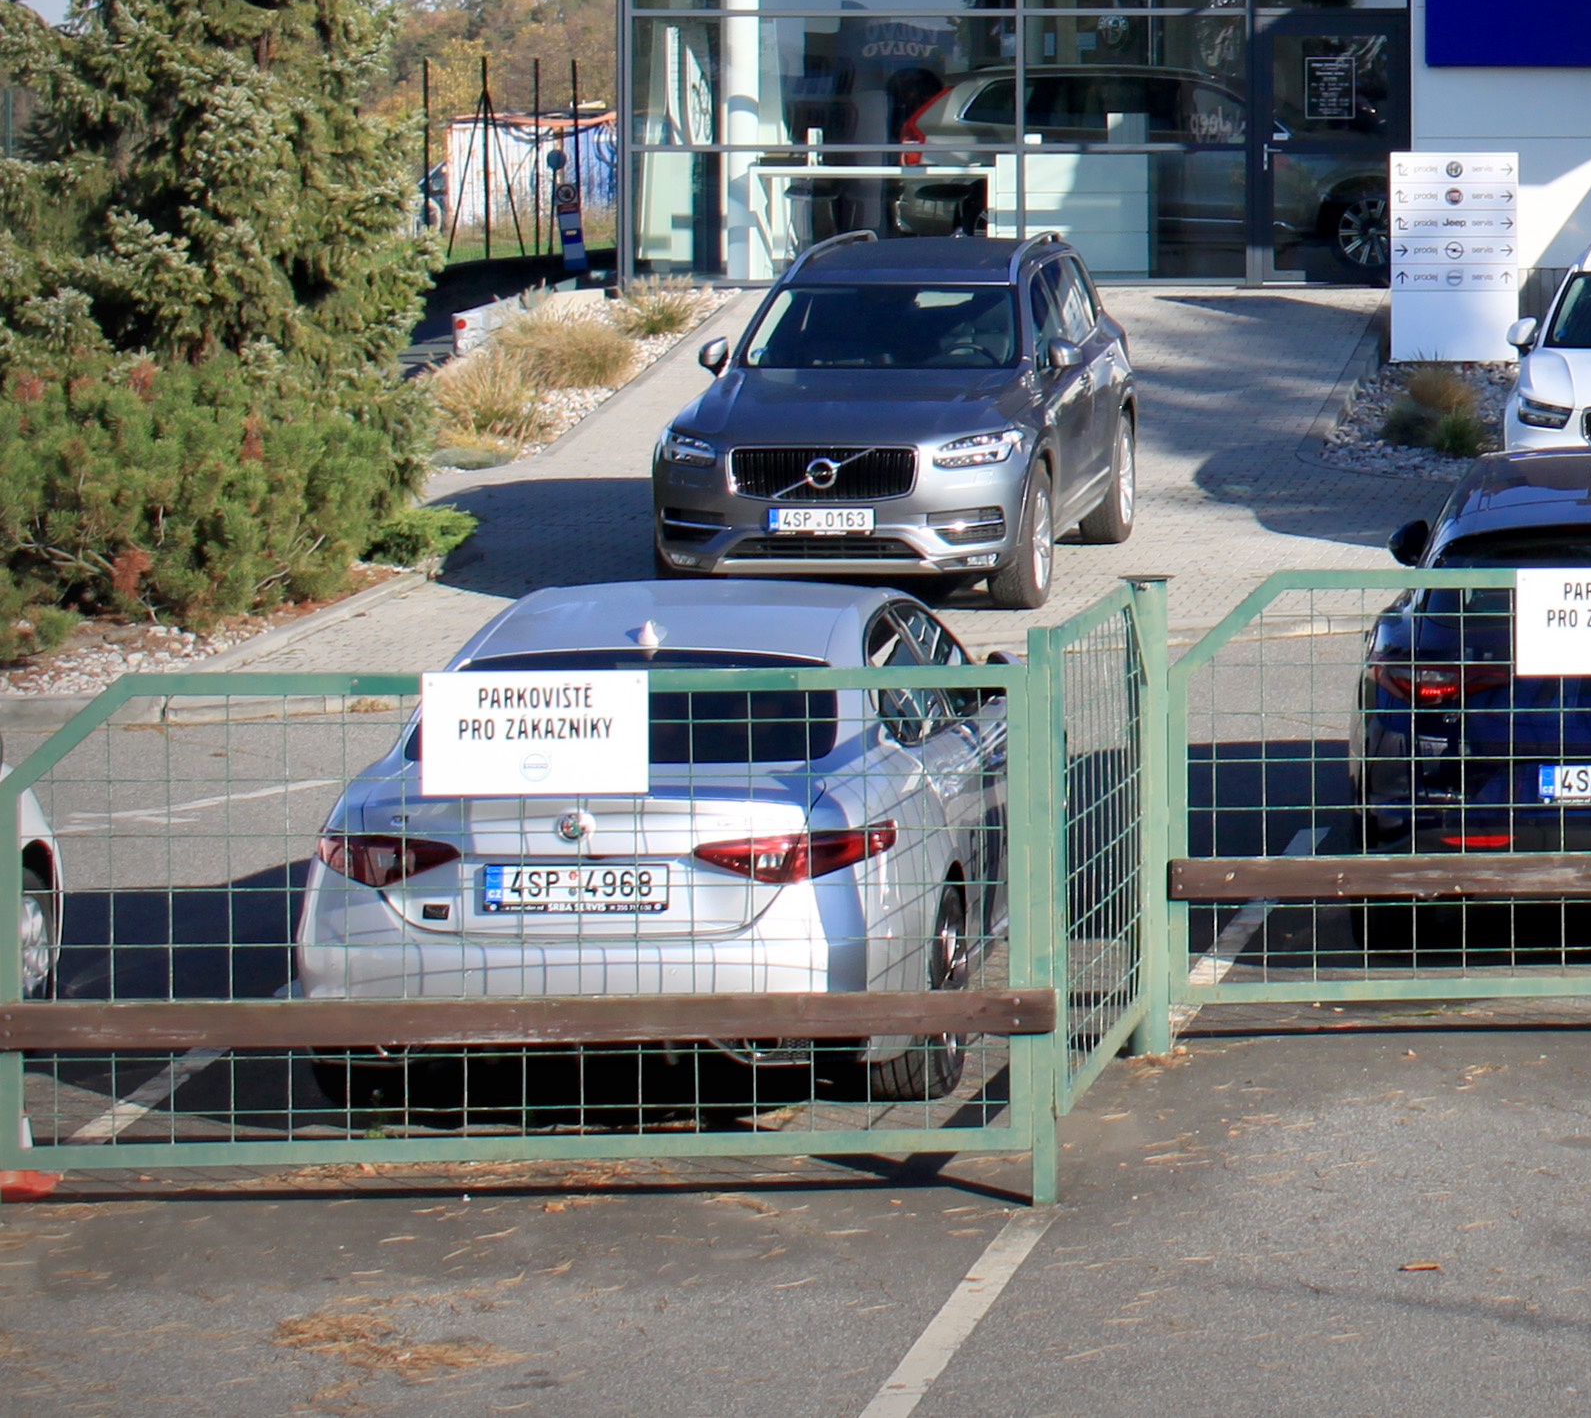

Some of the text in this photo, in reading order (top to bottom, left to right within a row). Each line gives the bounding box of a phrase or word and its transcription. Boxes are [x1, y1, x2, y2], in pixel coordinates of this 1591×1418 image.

[1442, 218, 1467, 228] Jeep
[783, 511, 866, 528] 4SP 0163
[1547, 608, 1578, 627] PRO
[478, 683, 593, 709] PARKOVIŠTĚ
[458, 714, 613, 740] PRO ZÁKAZNÍKY
[510, 870, 652, 897] 4SP 4968
[488, 889, 502, 898] CZ
